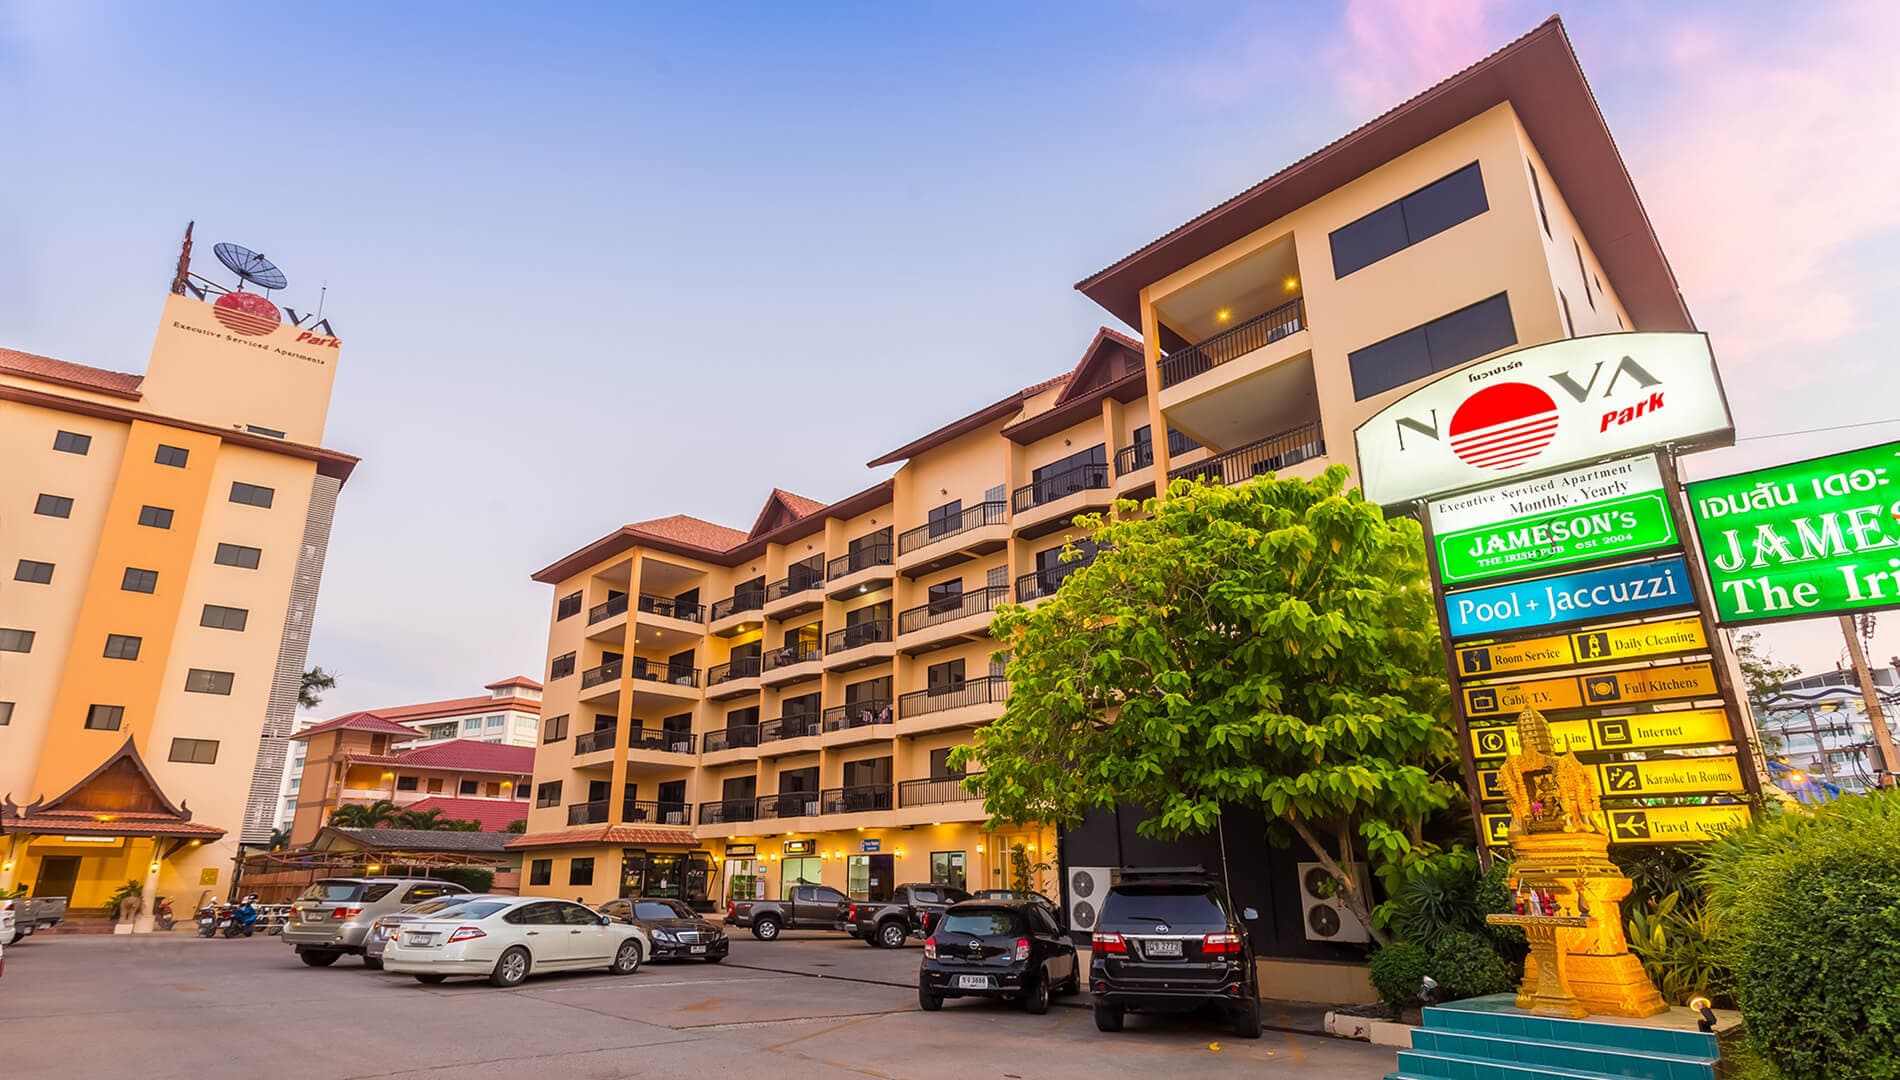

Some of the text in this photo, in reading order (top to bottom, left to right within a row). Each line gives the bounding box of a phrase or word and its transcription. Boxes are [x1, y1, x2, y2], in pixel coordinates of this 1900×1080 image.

[173, 321, 326, 365] Executive Serviced Apartments
[295, 332, 342, 349] Park
[1600, 391, 1665, 433] Park
[1439, 463, 1634, 514] Executive Serviced Apartment
[1510, 492, 1570, 515] Monthly
[1580, 480, 1630, 499] Yearly
[1699, 468, 1890, 519] เจมสัน เดอะ
[1468, 510, 1638, 557] JAMESON'S
[1477, 533, 1634, 568] THE IRISH PUB est 2004
[1458, 592, 1521, 625] Pool
[1544, 569, 1678, 620] Jaccuzzi
[1722, 576, 1820, 615] The
[1494, 650, 1561, 665] Room Service
[1614, 631, 1697, 651] Daily Cleaning
[1624, 677, 1699, 694] Full Kitchens
[1637, 725, 1684, 739] Internet
[1645, 770, 1733, 786] Karaoke In Rooms
[1651, 820, 1690, 833] Travel
